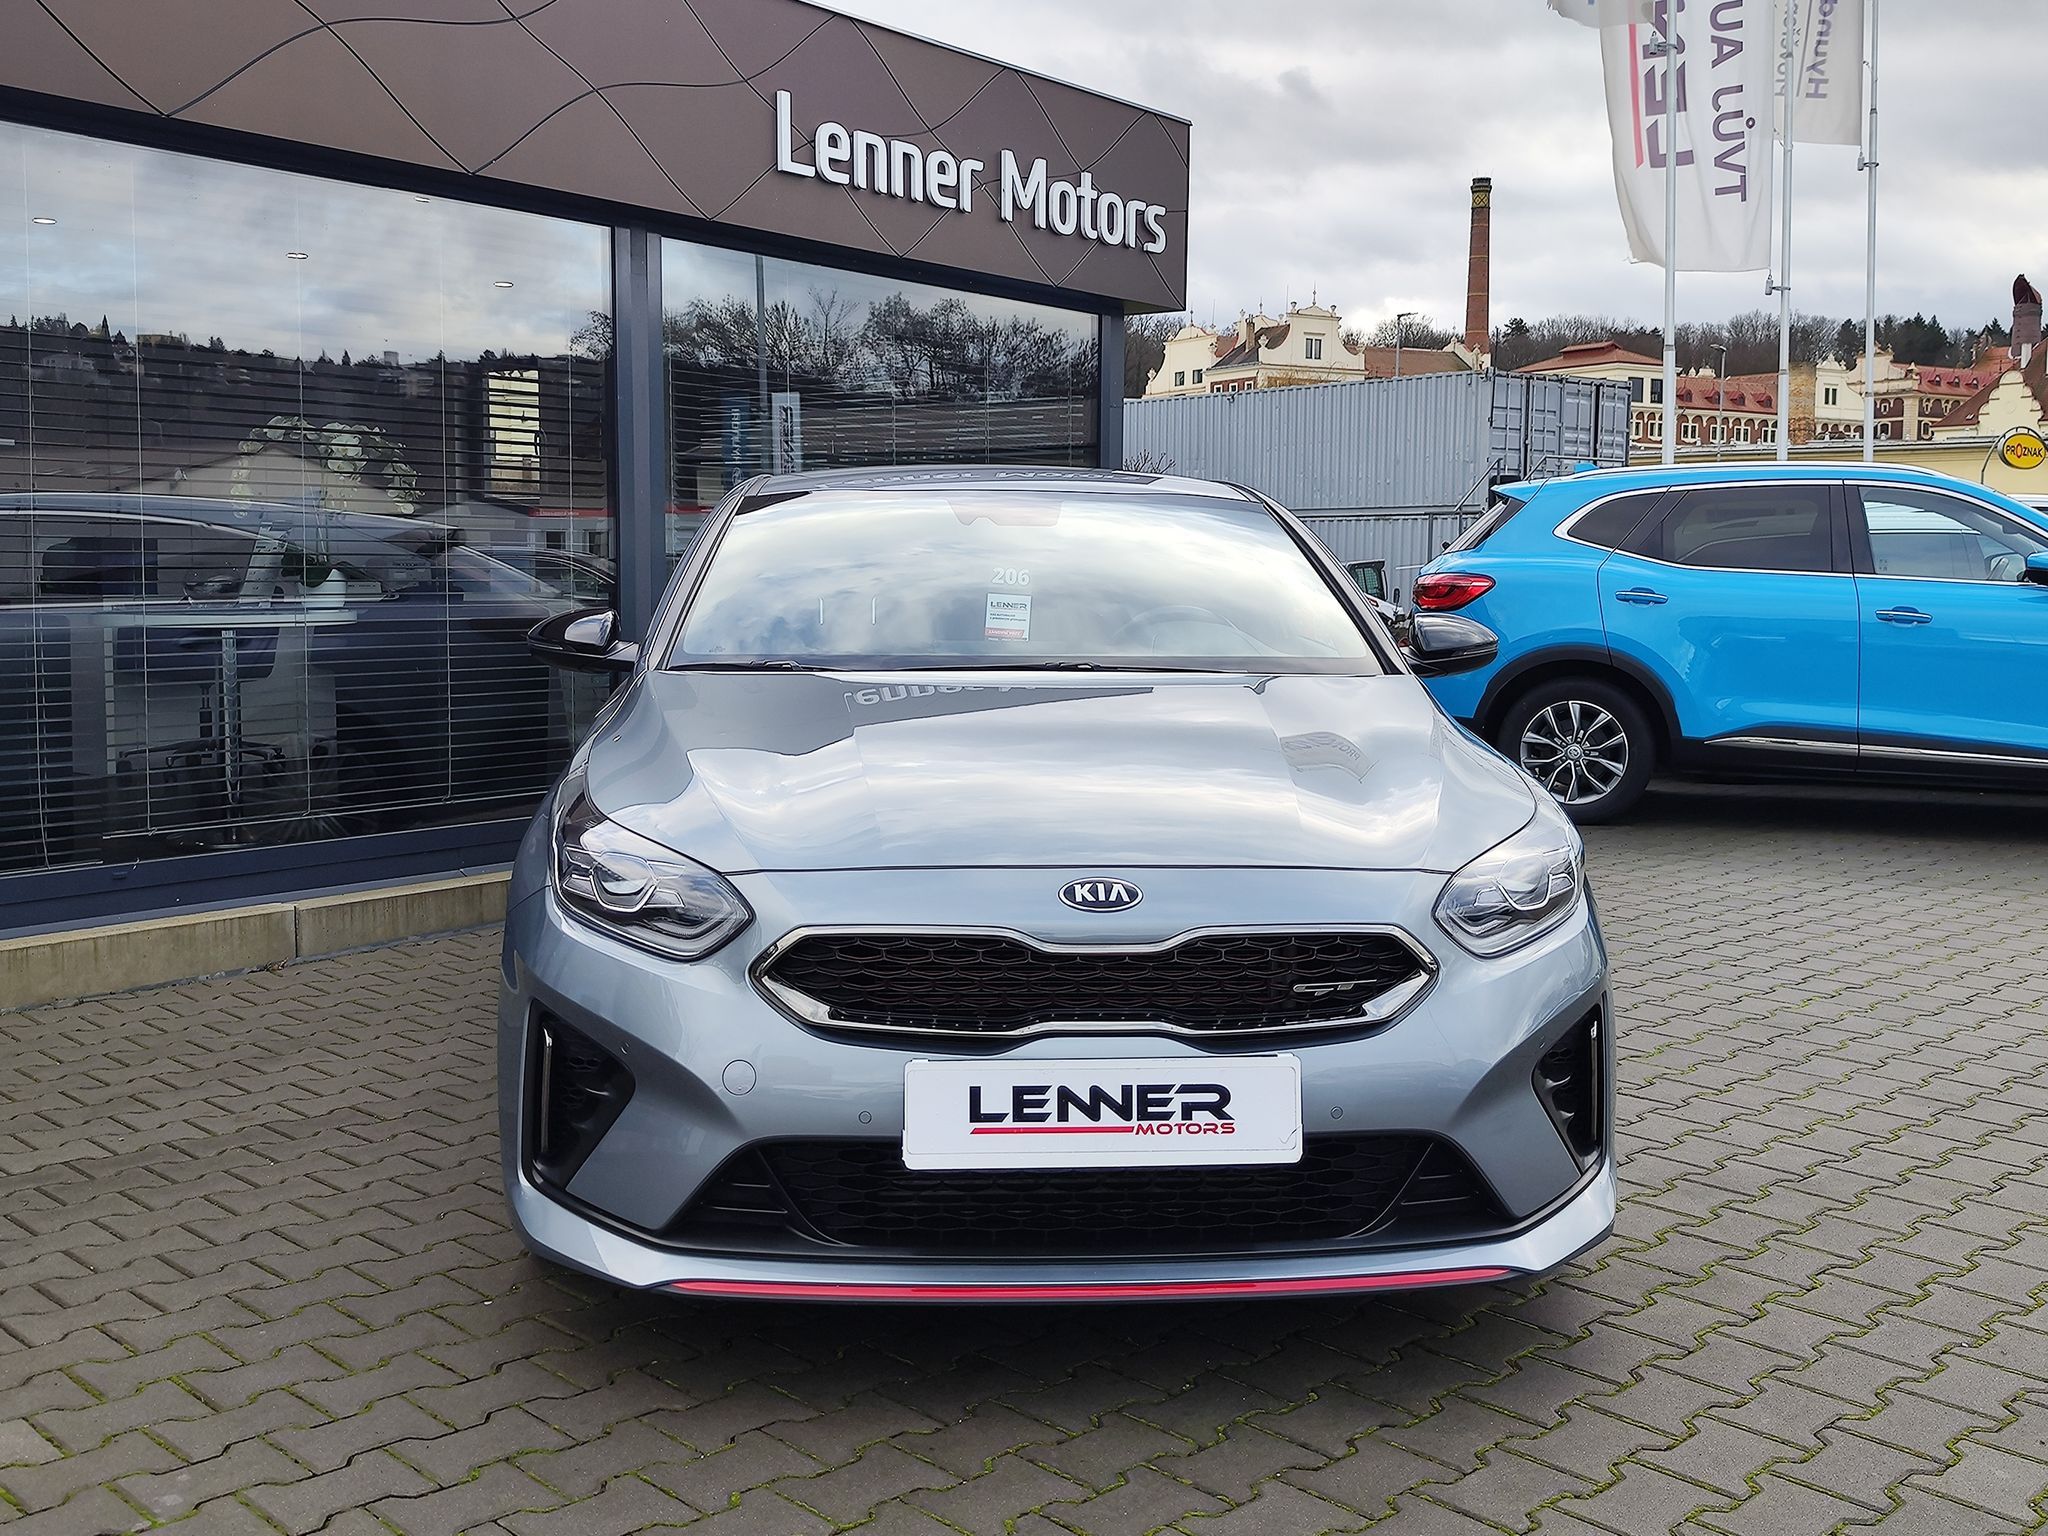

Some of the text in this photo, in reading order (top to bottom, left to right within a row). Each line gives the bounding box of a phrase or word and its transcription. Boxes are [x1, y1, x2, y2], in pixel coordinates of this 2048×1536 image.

[776, 89, 1168, 255] Lenner Motors
[2005, 443, 2043, 459] PROZNAK
[991, 567, 1031, 587] 206
[1073, 882, 1131, 902] KIA
[969, 1083, 1235, 1123] LENNER
[1134, 1122, 1236, 1136] MOTORS
